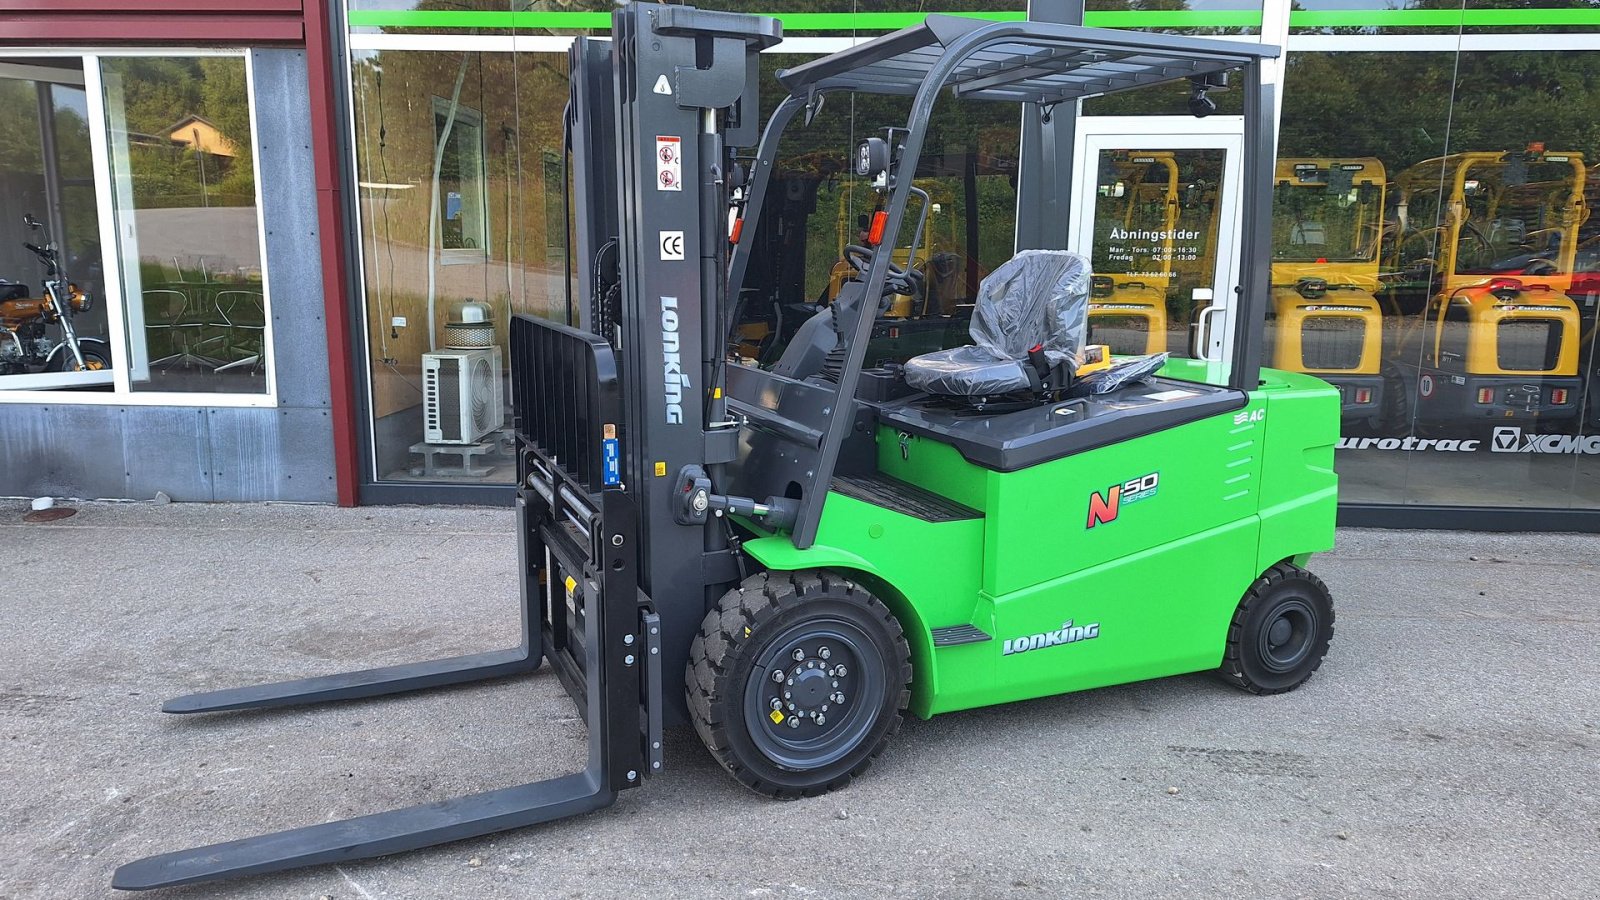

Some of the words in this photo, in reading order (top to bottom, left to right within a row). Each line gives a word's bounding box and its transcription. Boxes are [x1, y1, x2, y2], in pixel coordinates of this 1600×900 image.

[662, 236, 682, 255] CE
[1108, 254, 1134, 262] Fredag
[1249, 408, 1265, 422] AC
[1334, 436, 1481, 452] urotrac
[1518, 433, 1600, 455] XCMG
[1121, 487, 1158, 505] SERIES
